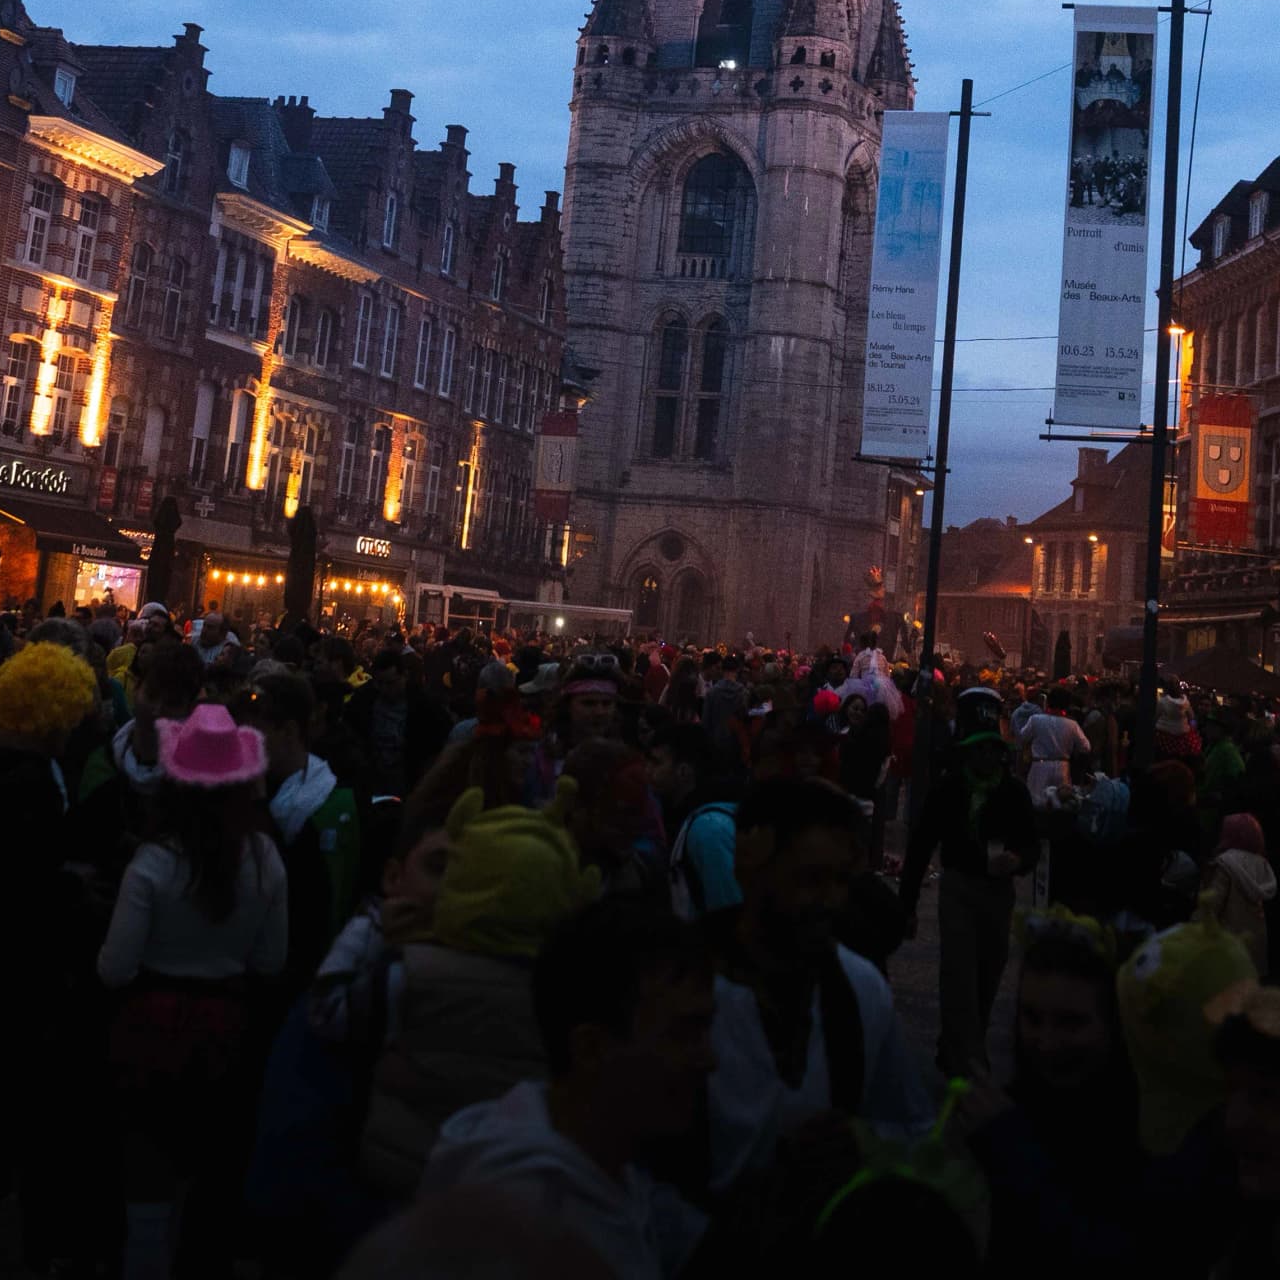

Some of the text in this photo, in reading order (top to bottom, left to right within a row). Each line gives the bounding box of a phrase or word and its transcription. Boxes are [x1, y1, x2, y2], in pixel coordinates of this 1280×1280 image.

[1067, 226, 1102, 239] Portrait
[1064, 279, 1096, 290] Musée
[1063, 291, 1142, 304] des Beaux-Arts
[1060, 344, 1095, 358] 10.6.23
